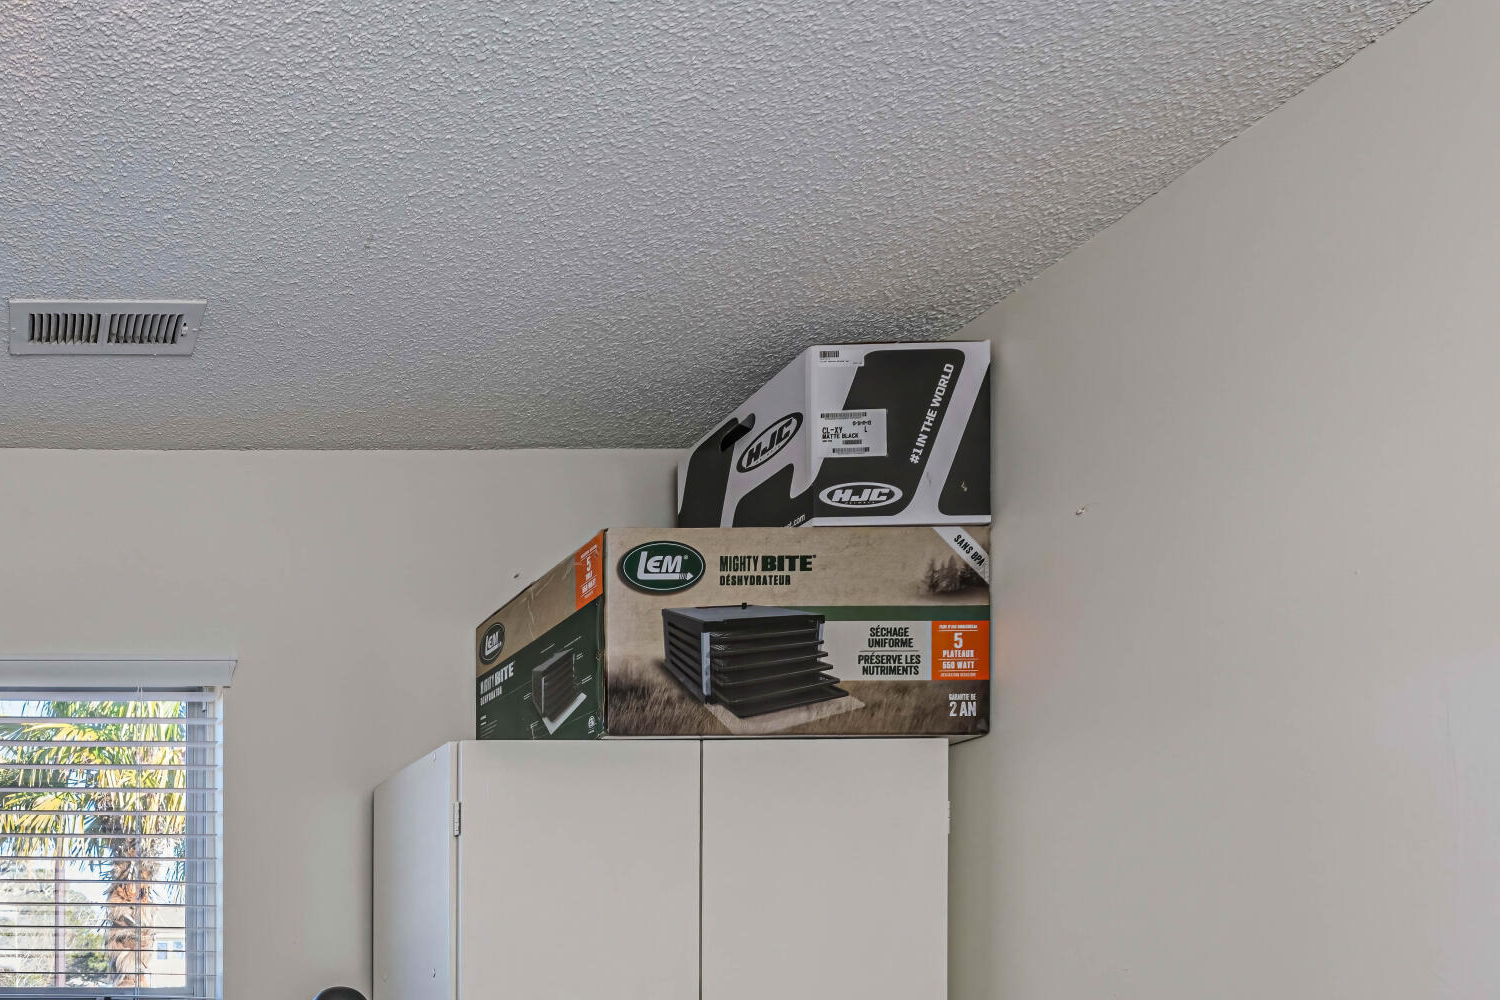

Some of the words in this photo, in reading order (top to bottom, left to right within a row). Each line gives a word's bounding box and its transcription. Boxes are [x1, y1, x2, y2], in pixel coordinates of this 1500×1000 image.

[930, 363, 955, 407] WORLD
[920, 406, 938, 433] THE
[745, 418, 793, 468] HJC
[916, 432, 928, 448] IN
[909, 447, 924, 464] #1
[831, 488, 891, 502] HJC
[954, 534, 974, 554] SANS
[970, 551, 985, 567] BPA
[719, 555, 759, 572] MIGHTY
[761, 554, 813, 572] BITE
[719, 574, 791, 586] DÉSHYDRATEUR
[869, 624, 910, 637] SÉCHAGE
[867, 637, 914, 648] UNIFORME
[953, 632, 964, 649] 5
[857, 652, 903, 665] PRÉSERVE
[904, 654, 922, 665] LES
[956, 661, 975, 669] WATT
[862, 665, 920, 676] NUTRIMENTS
[949, 701, 957, 717] 2
[959, 701, 977, 717] AN
